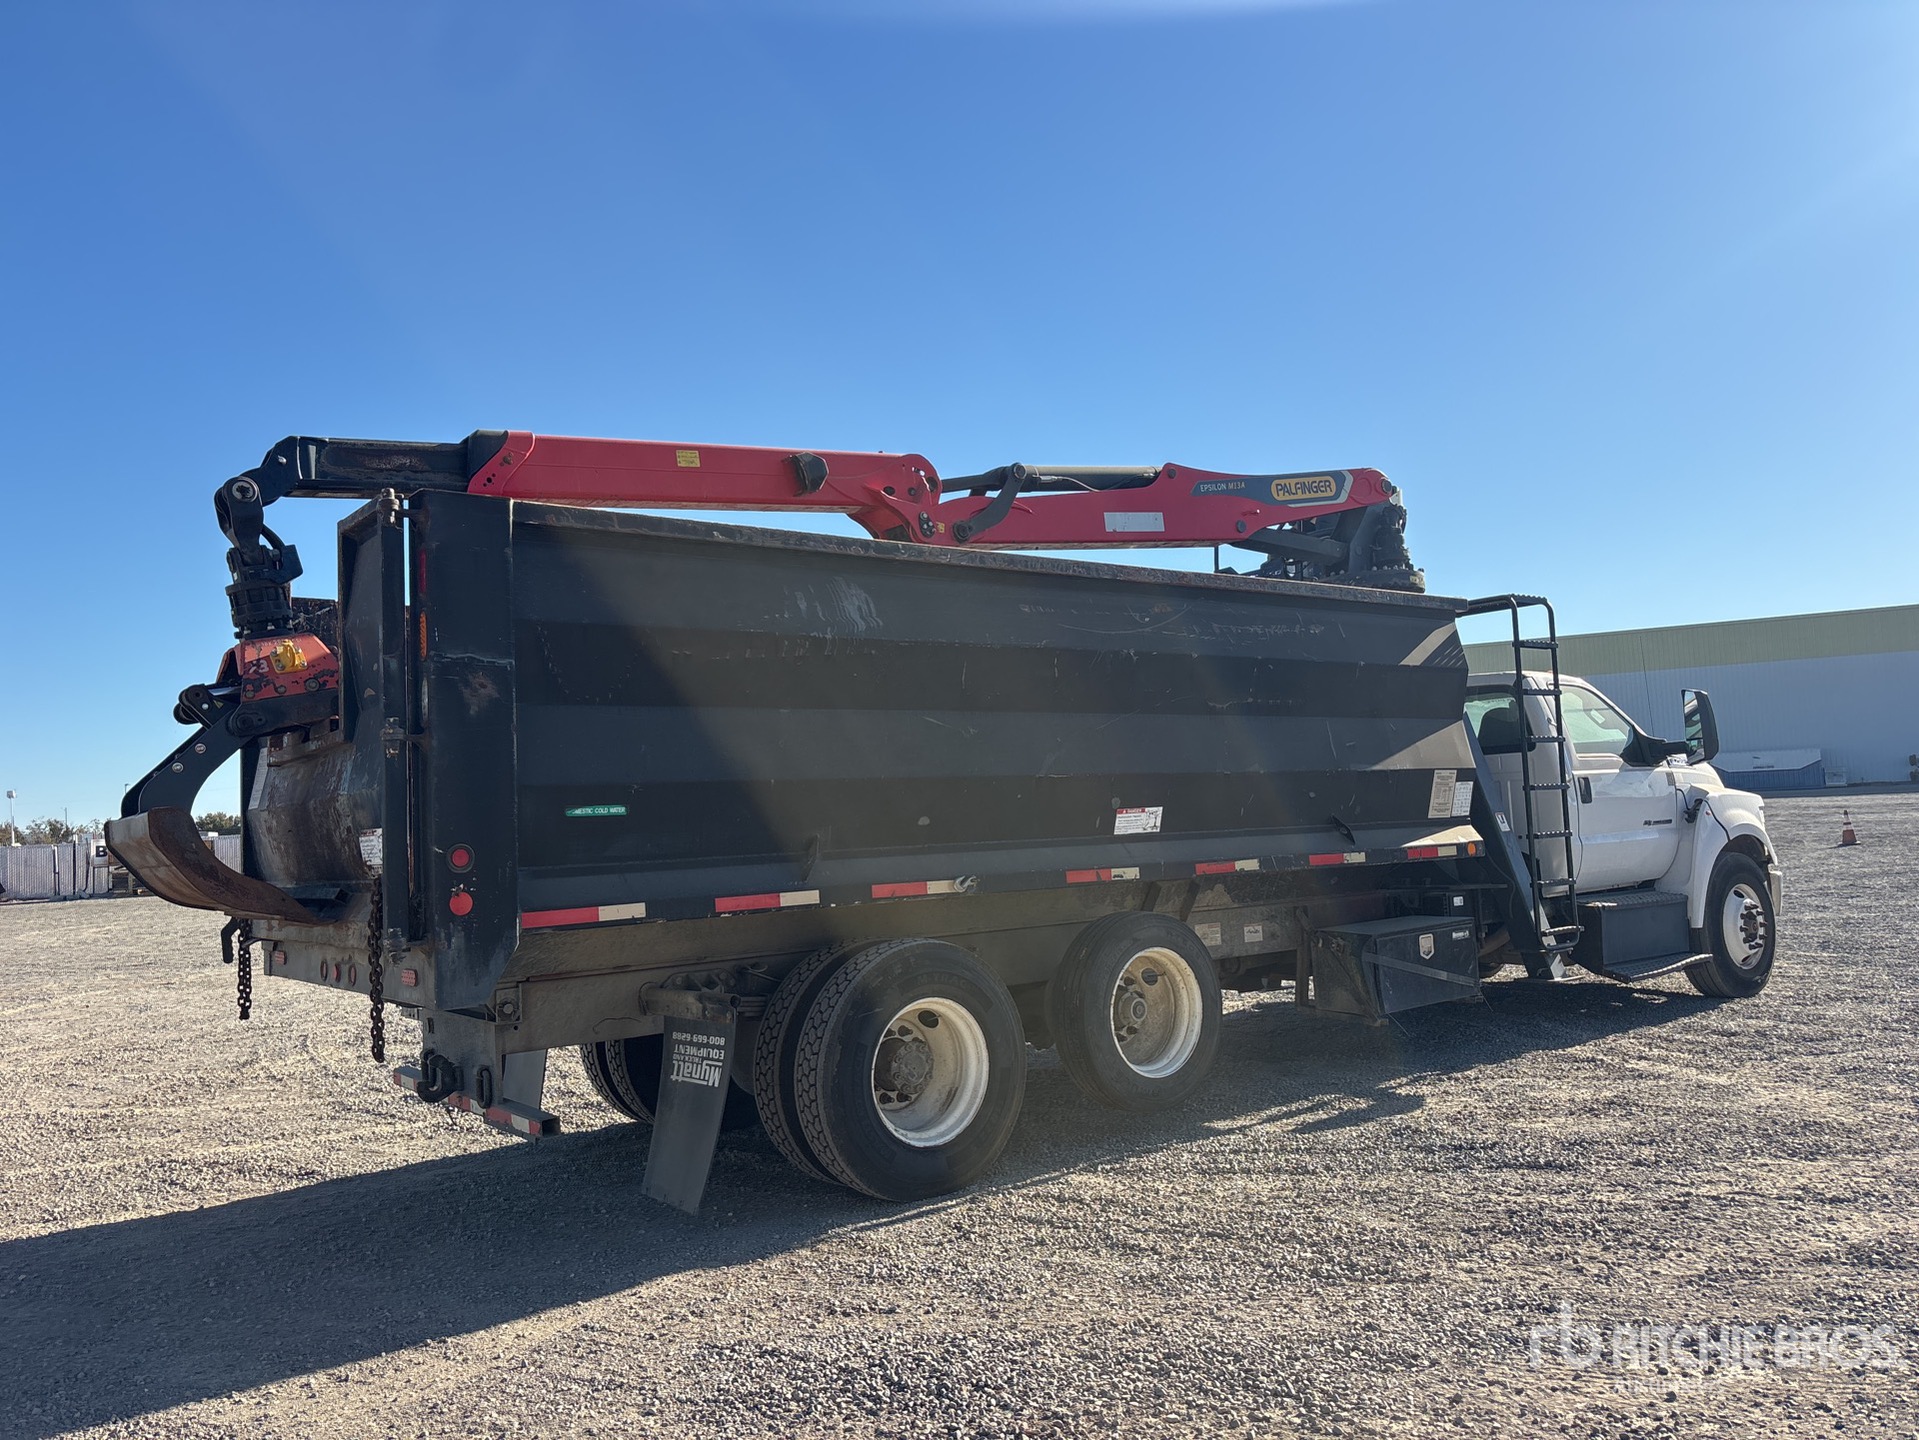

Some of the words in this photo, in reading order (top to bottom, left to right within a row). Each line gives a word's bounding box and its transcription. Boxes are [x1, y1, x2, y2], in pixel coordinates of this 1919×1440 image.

[1199, 483, 1227, 493] EPSILON
[1228, 480, 1246, 490] M13A
[1275, 479, 1333, 497] PALFINGER
[673, 1043, 725, 1060] EQUIPMENT
[670, 1059, 723, 1088] Mynatt
